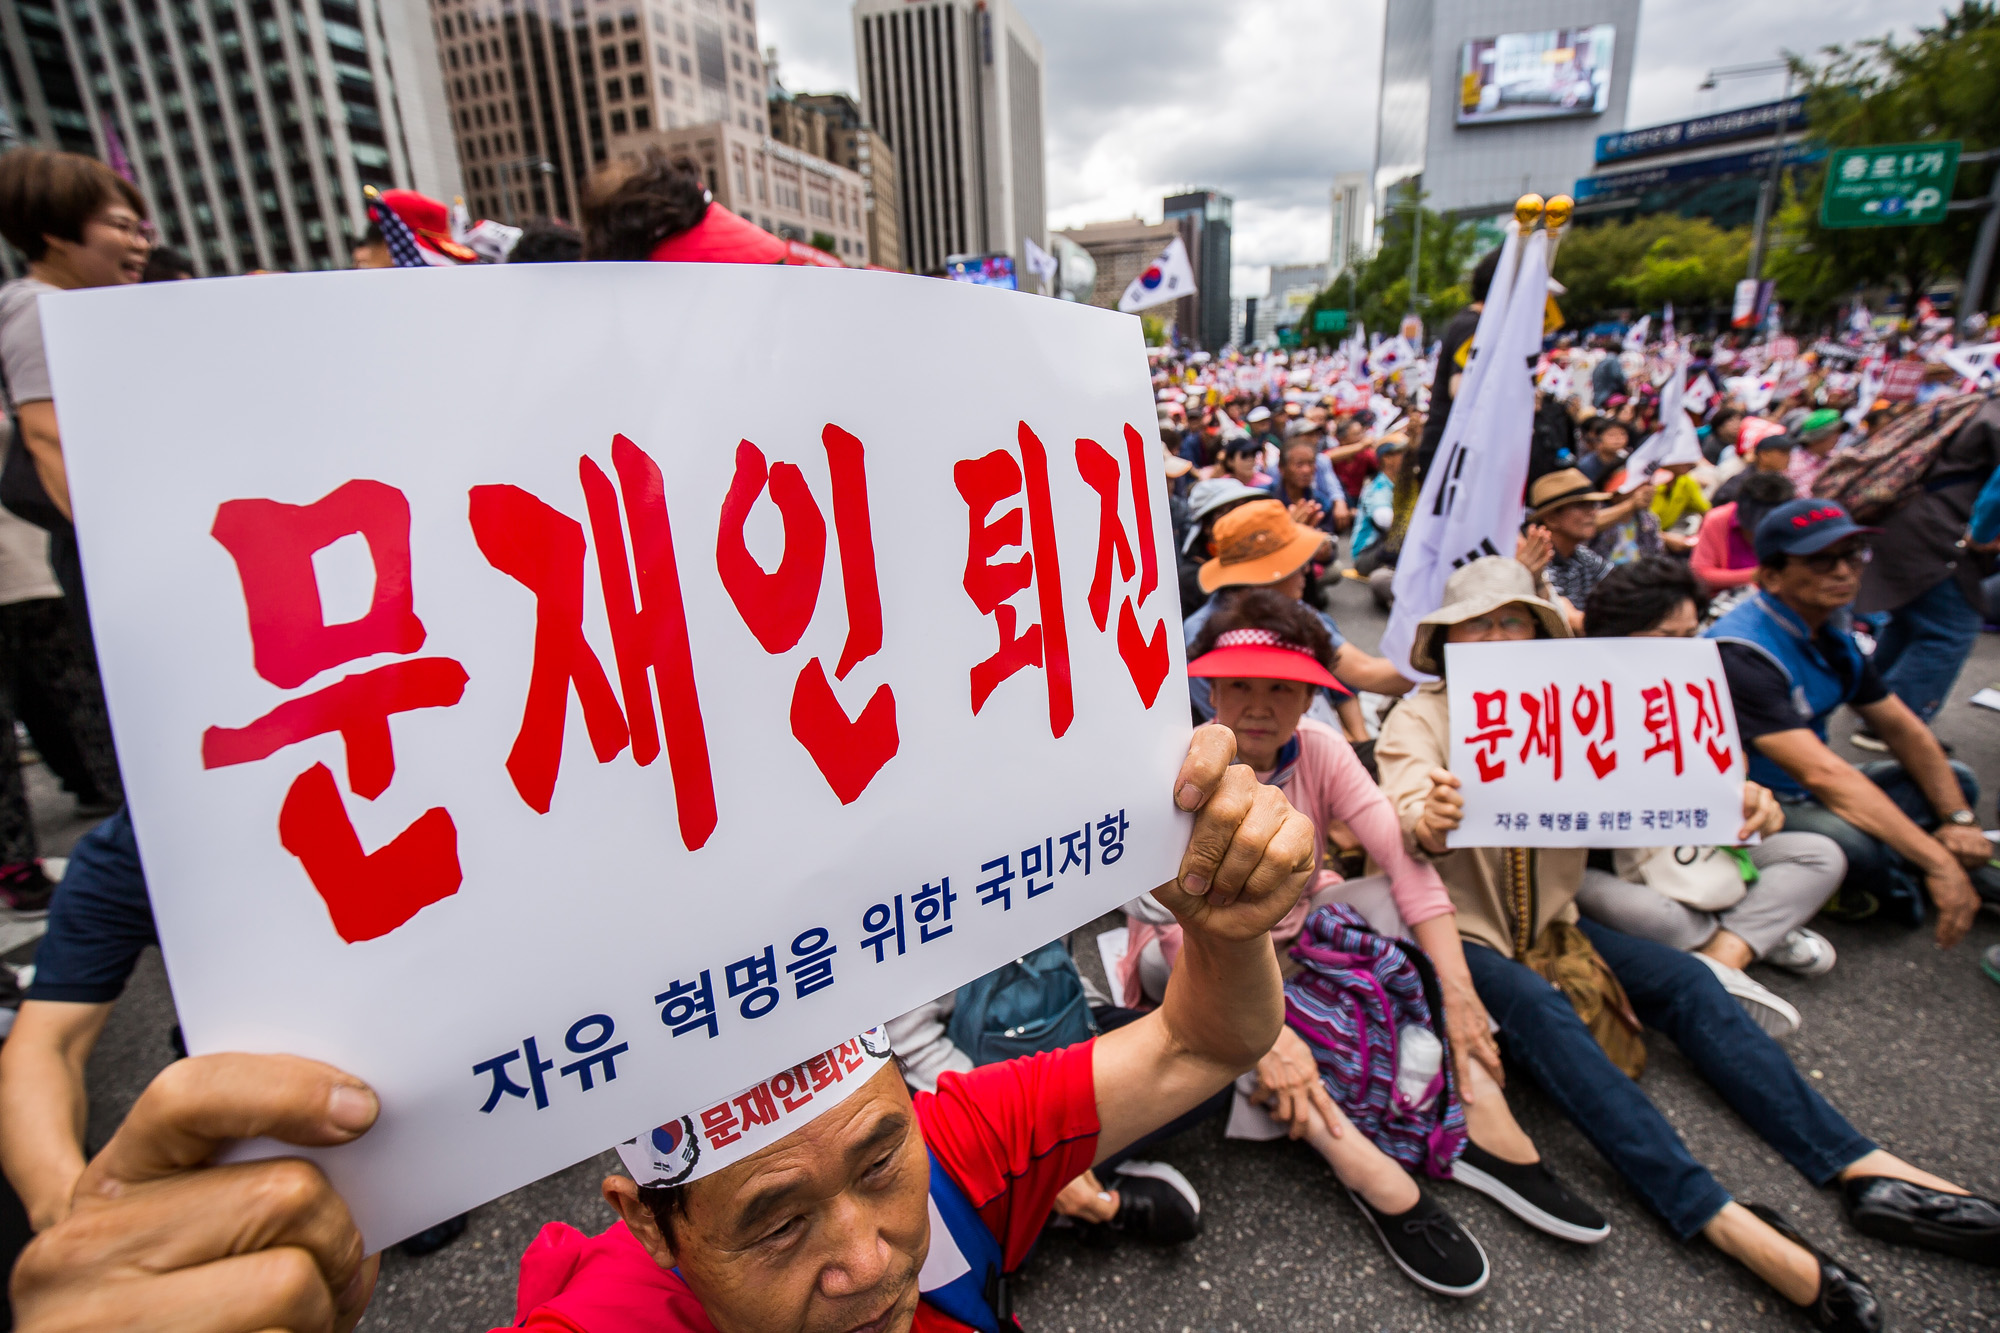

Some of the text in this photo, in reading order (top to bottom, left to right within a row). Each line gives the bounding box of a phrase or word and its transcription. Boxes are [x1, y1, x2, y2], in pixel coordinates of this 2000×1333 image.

[202, 421, 1169, 944] 문재인 퇴진
[1464, 678, 1733, 783] 문재인 퇴진
[1495, 808, 1710, 831] 자유 혁명을 위한 국민저항
[472, 809, 1131, 1114] 자유 혁명을 위한 국민저항
[700, 1037, 864, 1150] 문재인퇴진
